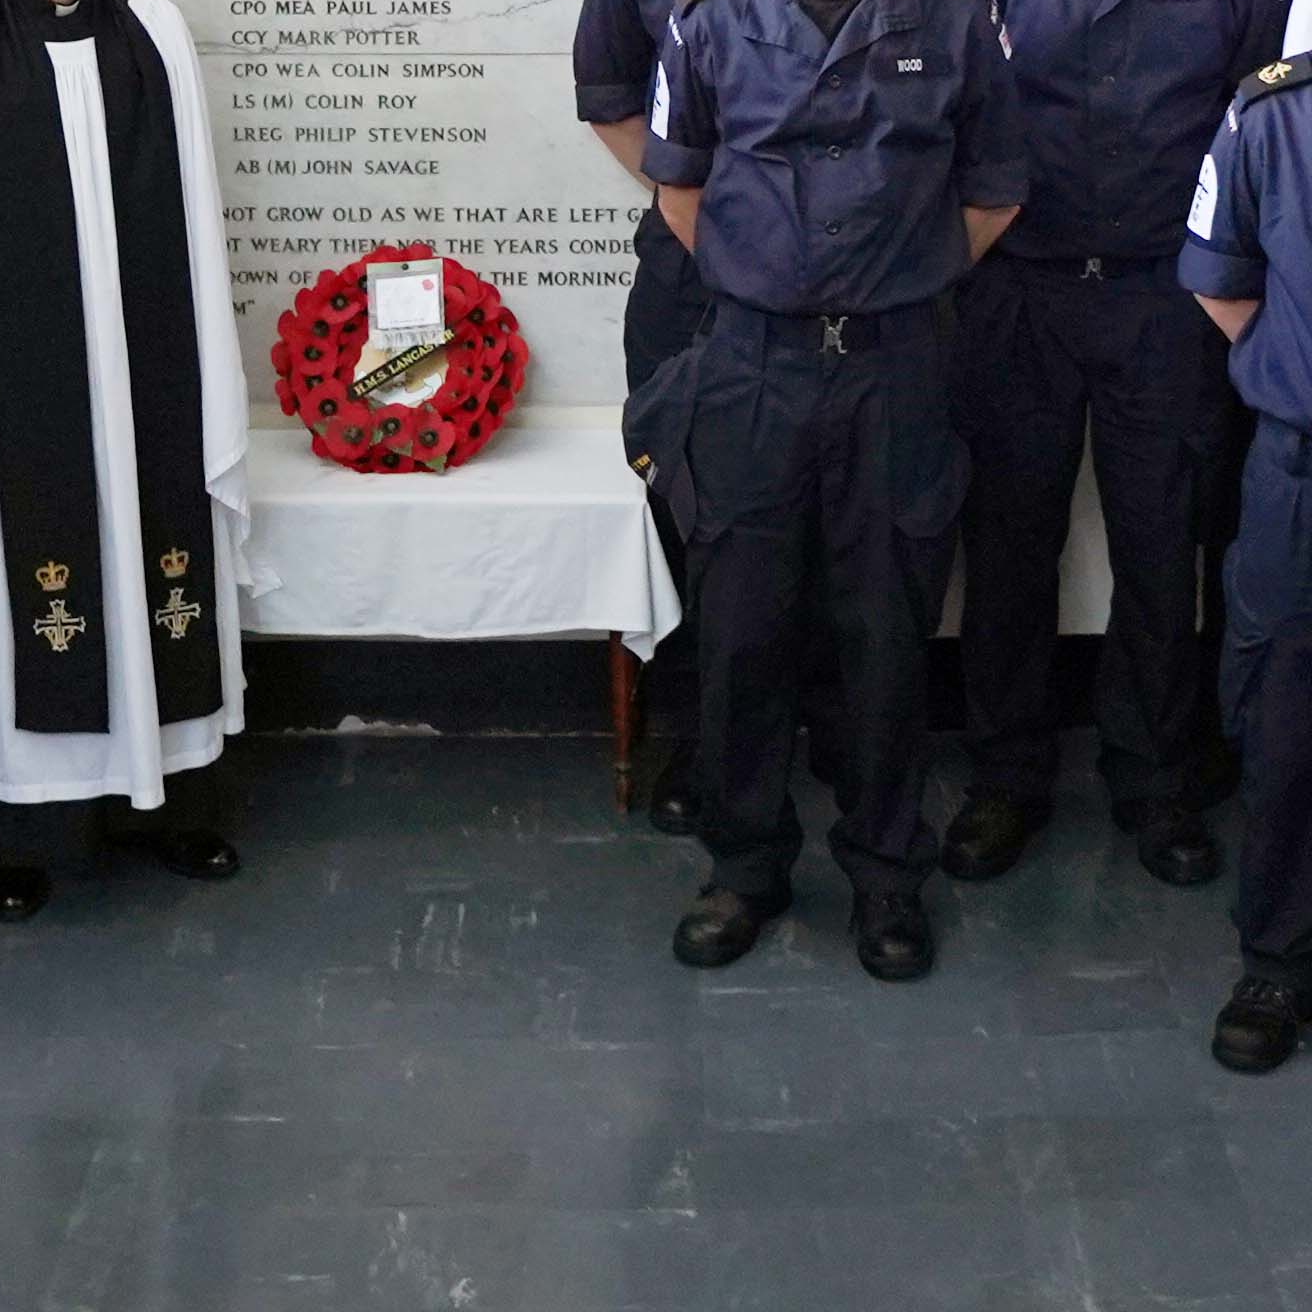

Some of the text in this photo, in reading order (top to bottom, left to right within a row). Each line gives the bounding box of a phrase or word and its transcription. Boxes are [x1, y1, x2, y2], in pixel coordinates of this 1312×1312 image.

[229, 0, 452, 18] CPO MEA PAUL JAMES
[229, 30, 421, 48] CCY MARK POTTER
[232, 62, 485, 79] CPO WEA COLIN SIMPSON
[896, 58, 923, 73] WOOD
[232, 93, 418, 111] LS (M) COLIN ROY
[232, 126, 487, 144] LREG PHILIP STEVENSON
[234, 159, 440, 177] AB (M) JOHN SAVAGE
[266, 206, 325, 223] GROW
[332, 206, 373, 223] OLD
[380, 206, 406, 223] AS
[412, 207, 445, 223] WE
[452, 207, 509, 223] THAT
[515, 207, 559, 224] ARE
[569, 207, 619, 224] LEFT
[250, 237, 323, 254] WEARY
[444, 238, 485, 256] THE
[493, 238, 559, 255] YEARS
[568, 238, 635, 255] CONDE
[288, 270, 313, 288] OF
[487, 271, 529, 288] THE
[537, 270, 631, 287] MORNING
